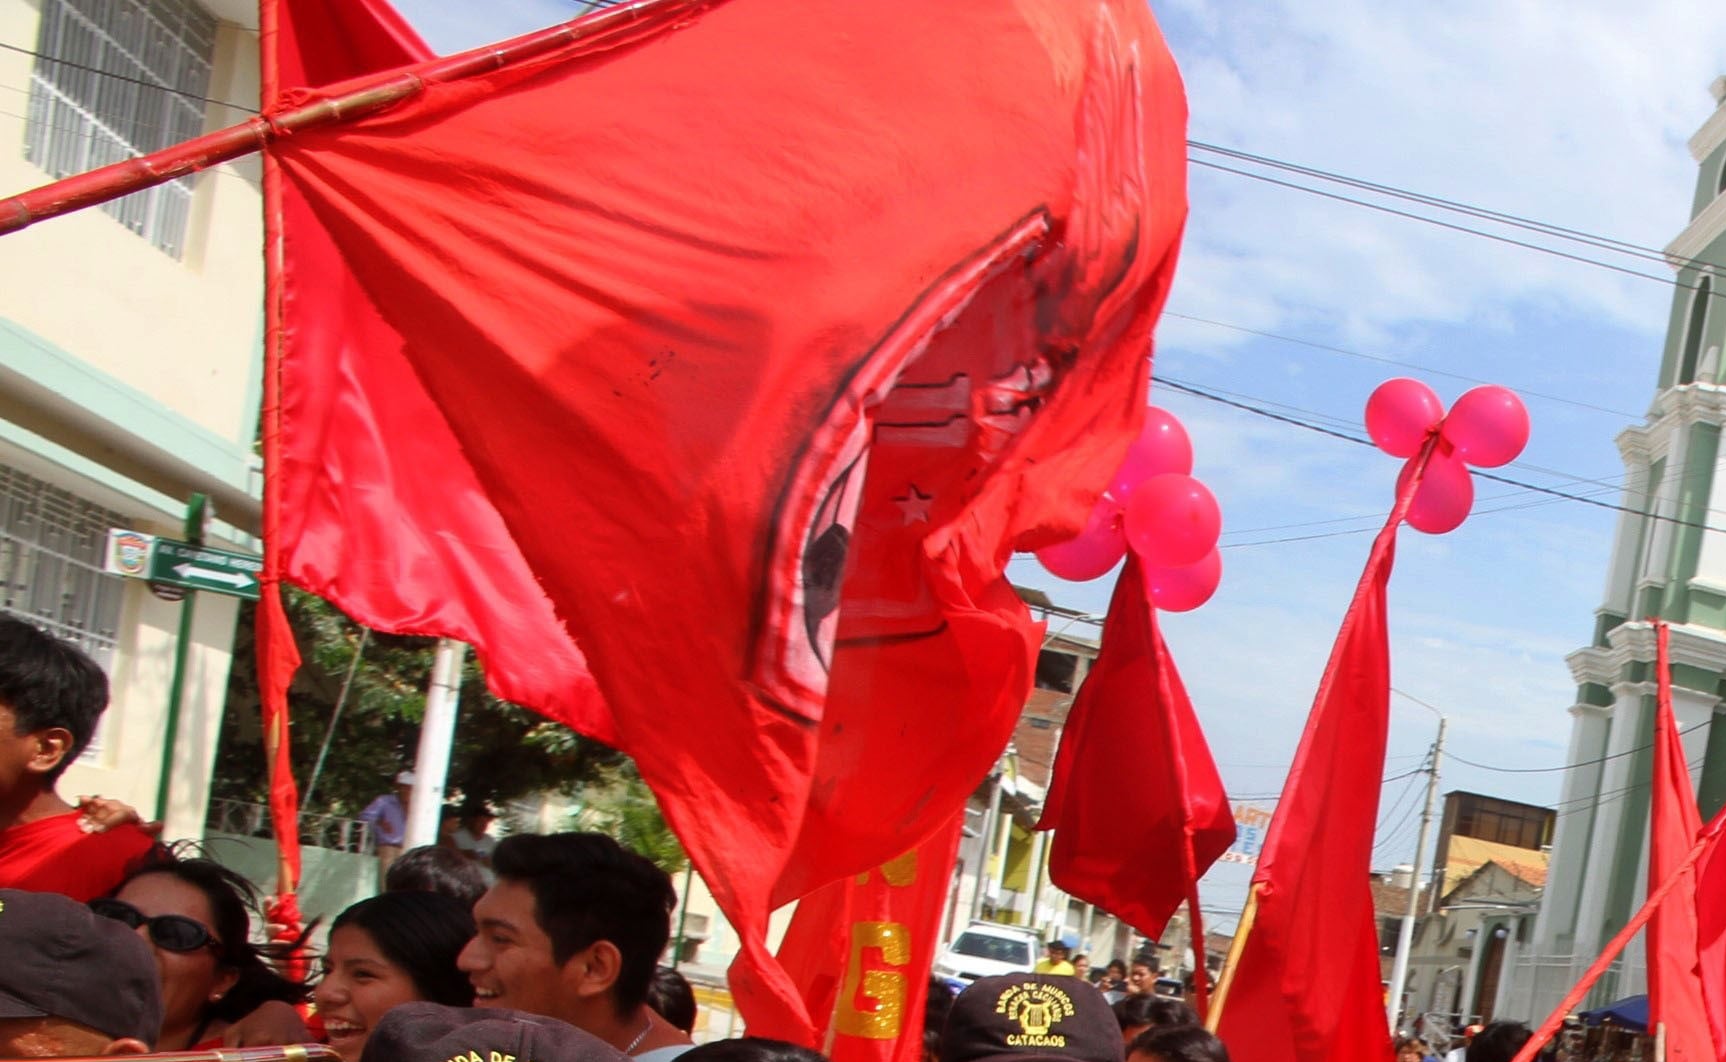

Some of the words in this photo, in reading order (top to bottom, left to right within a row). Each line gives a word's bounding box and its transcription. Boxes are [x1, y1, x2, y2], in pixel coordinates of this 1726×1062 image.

[1023, 982, 1038, 991] DE
[1041, 983, 1075, 1017] MUSICOS
[1006, 1033, 1066, 1048] CATACAOS
